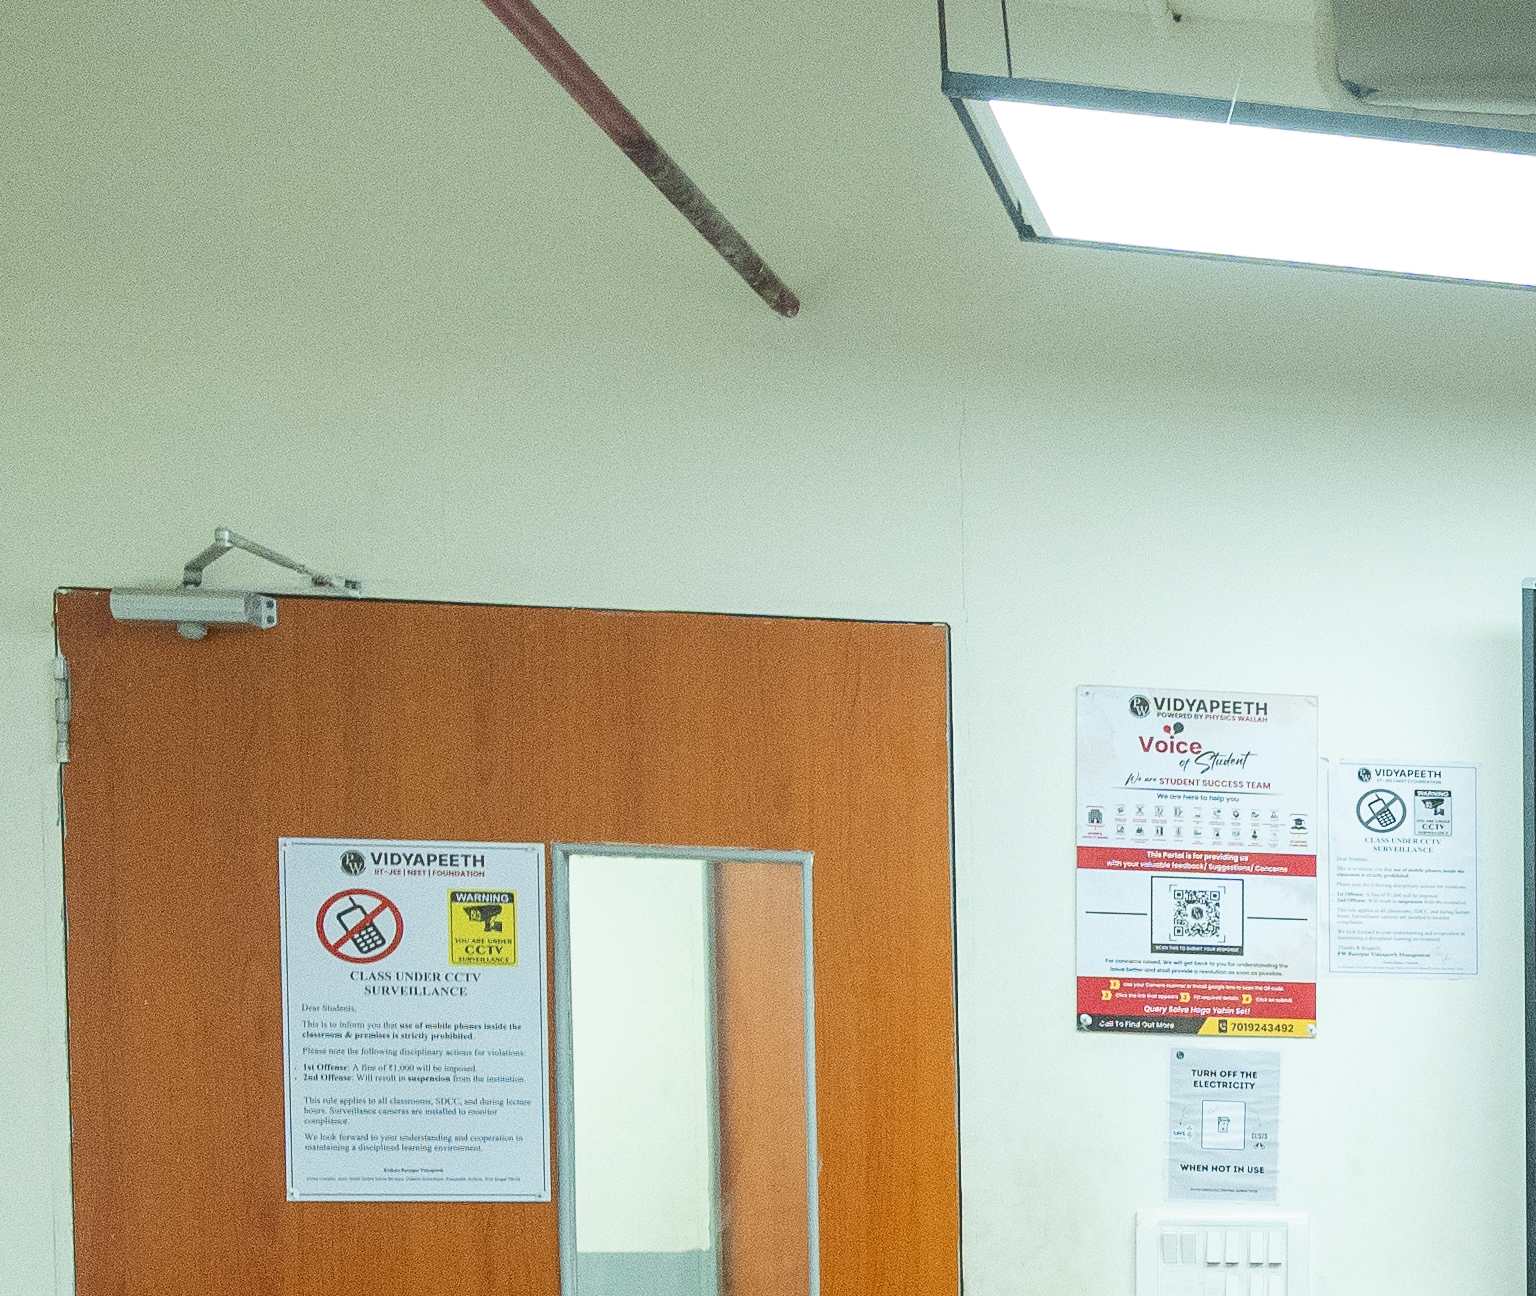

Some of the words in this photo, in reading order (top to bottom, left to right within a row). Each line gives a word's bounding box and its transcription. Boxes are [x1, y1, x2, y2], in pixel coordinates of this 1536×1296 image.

[1153, 697, 1268, 716] VIDYAPEETH
[1156, 712, 1193, 720] POWERED
[1237, 715, 1268, 723] WALLAH
[1138, 735, 1202, 755] Voice
[1179, 758, 1190, 771] of
[1194, 750, 1258, 774] Student
[1374, 768, 1442, 779] VIDYAPEETH
[1159, 777, 1200, 787] STUDENT
[1202, 779, 1244, 788] SUCCESS
[1246, 781, 1271, 790] TEAM
[370, 852, 485, 868] VIDYAPEETH
[455, 892, 509, 903] WARNING
[464, 945, 504, 955] CCTV
[350, 971, 392, 981] CLASS
[396, 971, 440, 982] UNDER
[444, 972, 481, 982] CCTV
[364, 985, 467, 997] SURVEILLANCE
[1144, 1005, 1168, 1014] Query
[1168, 1005, 1190, 1013] Solve
[1231, 1022, 1294, 1033] 7019243492
[1191, 1069, 1217, 1079] TURN
[1220, 1070, 1238, 1079] OFF
[1240, 1070, 1258, 1080] THE
[1192, 1080, 1256, 1091] ELECTRICITY
[1180, 1164, 1208, 1172] WHEN
[1211, 1165, 1231, 1173] NOT
[1234, 1165, 1245, 1173] IN
[1247, 1166, 1265, 1174] USE
